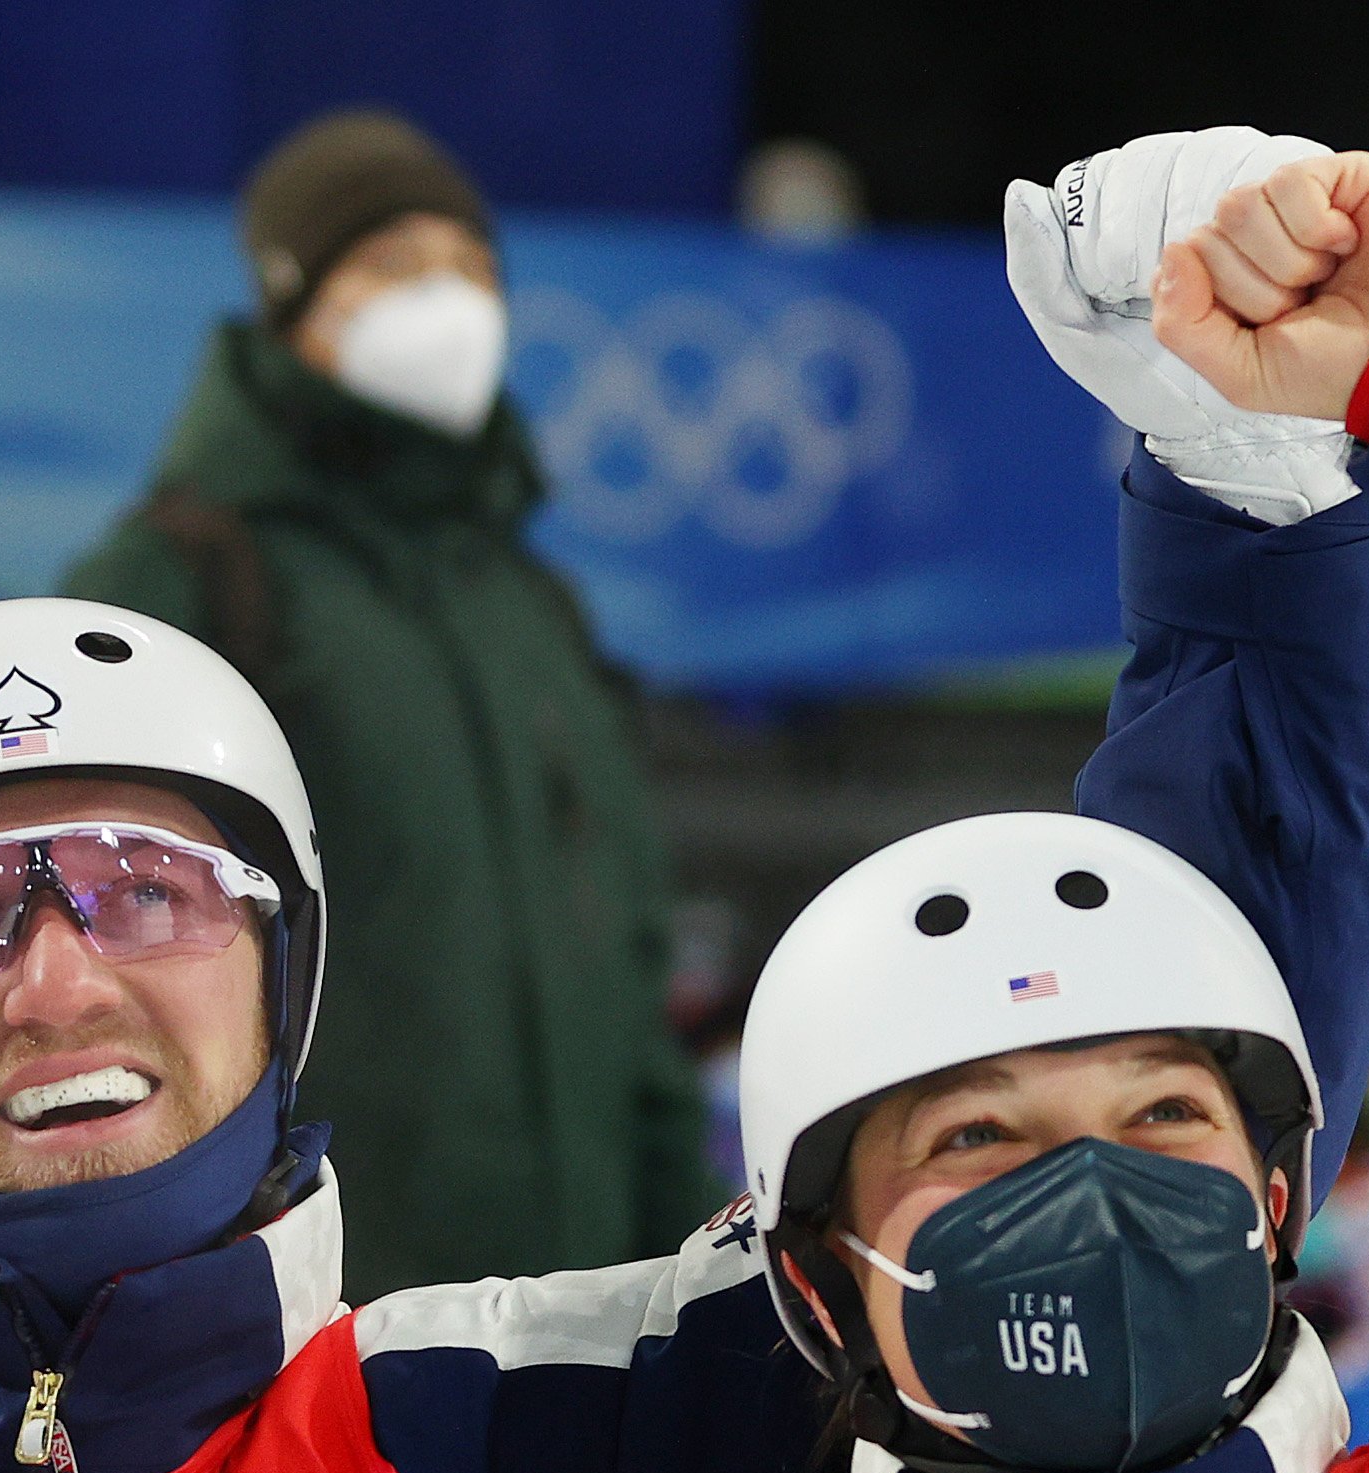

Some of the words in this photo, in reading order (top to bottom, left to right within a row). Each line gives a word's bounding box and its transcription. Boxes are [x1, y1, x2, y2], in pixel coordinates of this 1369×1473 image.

[1067, 156, 1091, 227] AUCLA
[1008, 1292, 1073, 1317] TEAM
[997, 1318, 1090, 1378] USA
